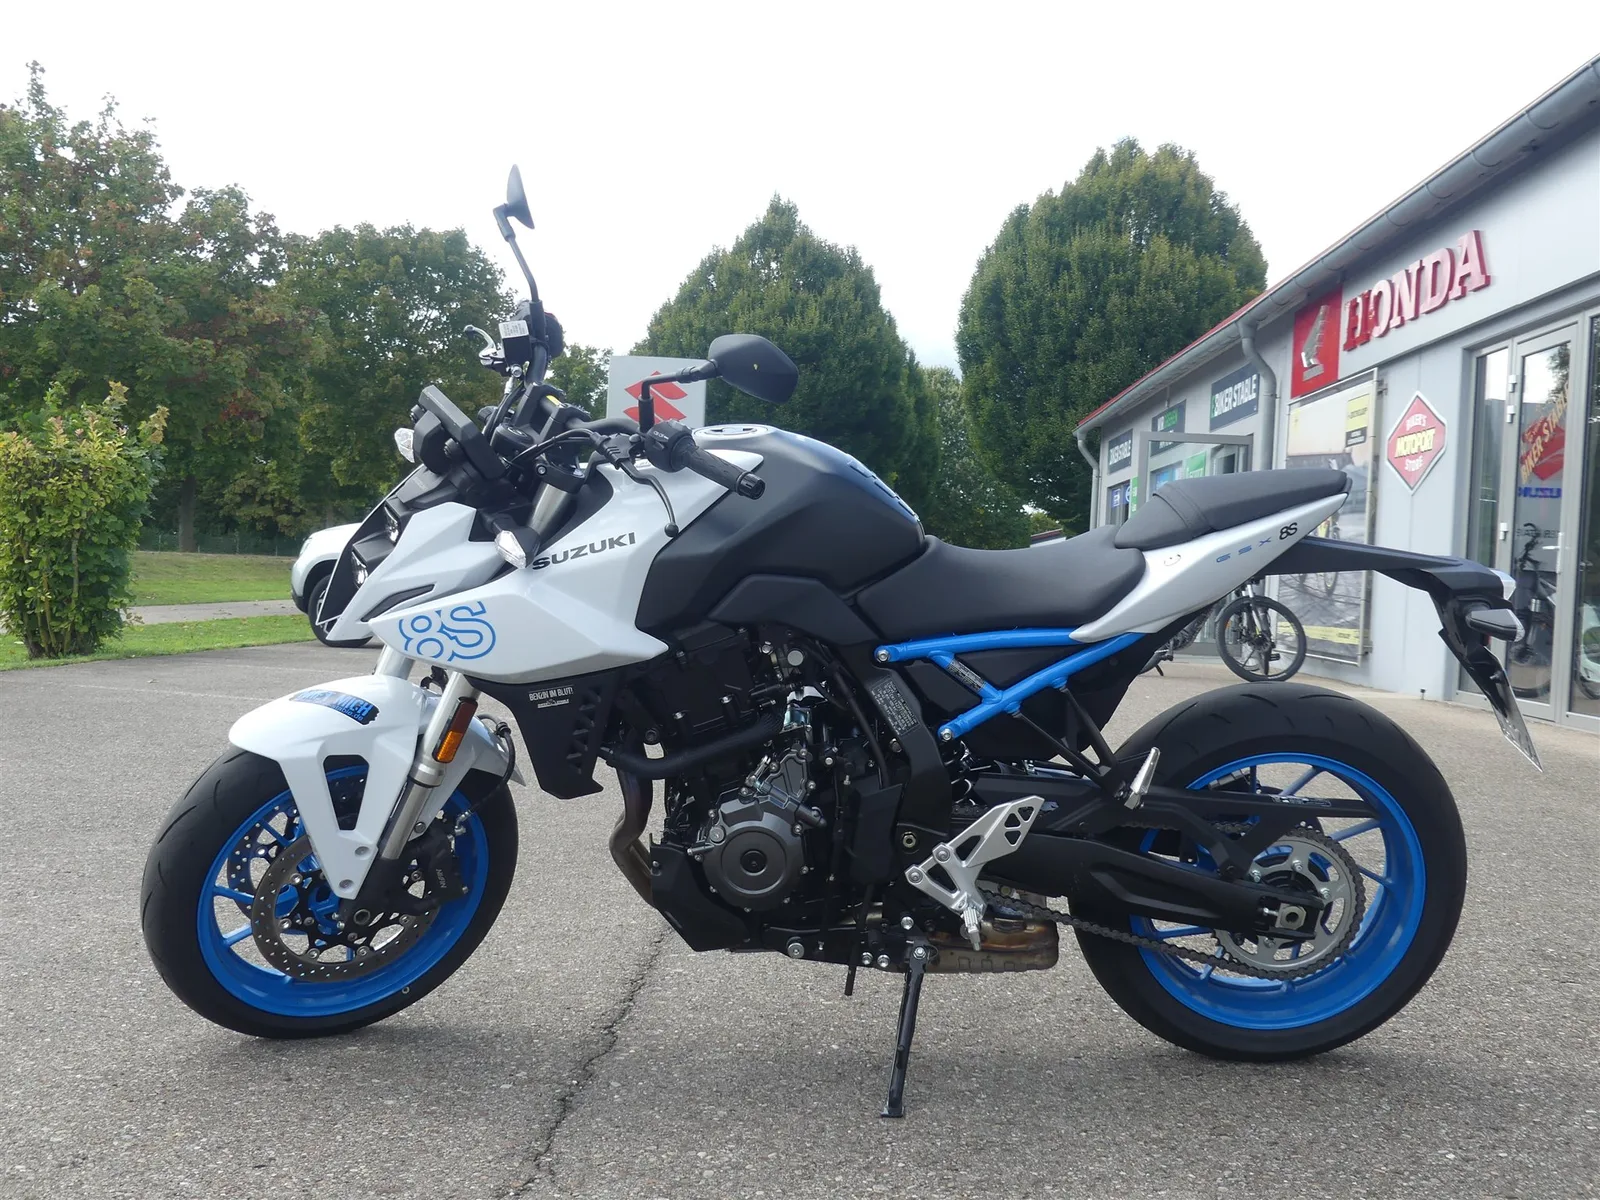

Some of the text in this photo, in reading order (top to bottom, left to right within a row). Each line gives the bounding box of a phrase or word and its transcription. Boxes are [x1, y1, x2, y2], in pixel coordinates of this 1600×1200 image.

[1343, 230, 1490, 351] HONDA
[1214, 373, 1258, 417] BIKER STABLE
[532, 531, 636, 570] SUZUKI
[1279, 522, 1298, 540] 8S
[399, 601, 496, 661] 8S
[334, 694, 374, 717] MICH
[549, 689, 557, 698] IM
